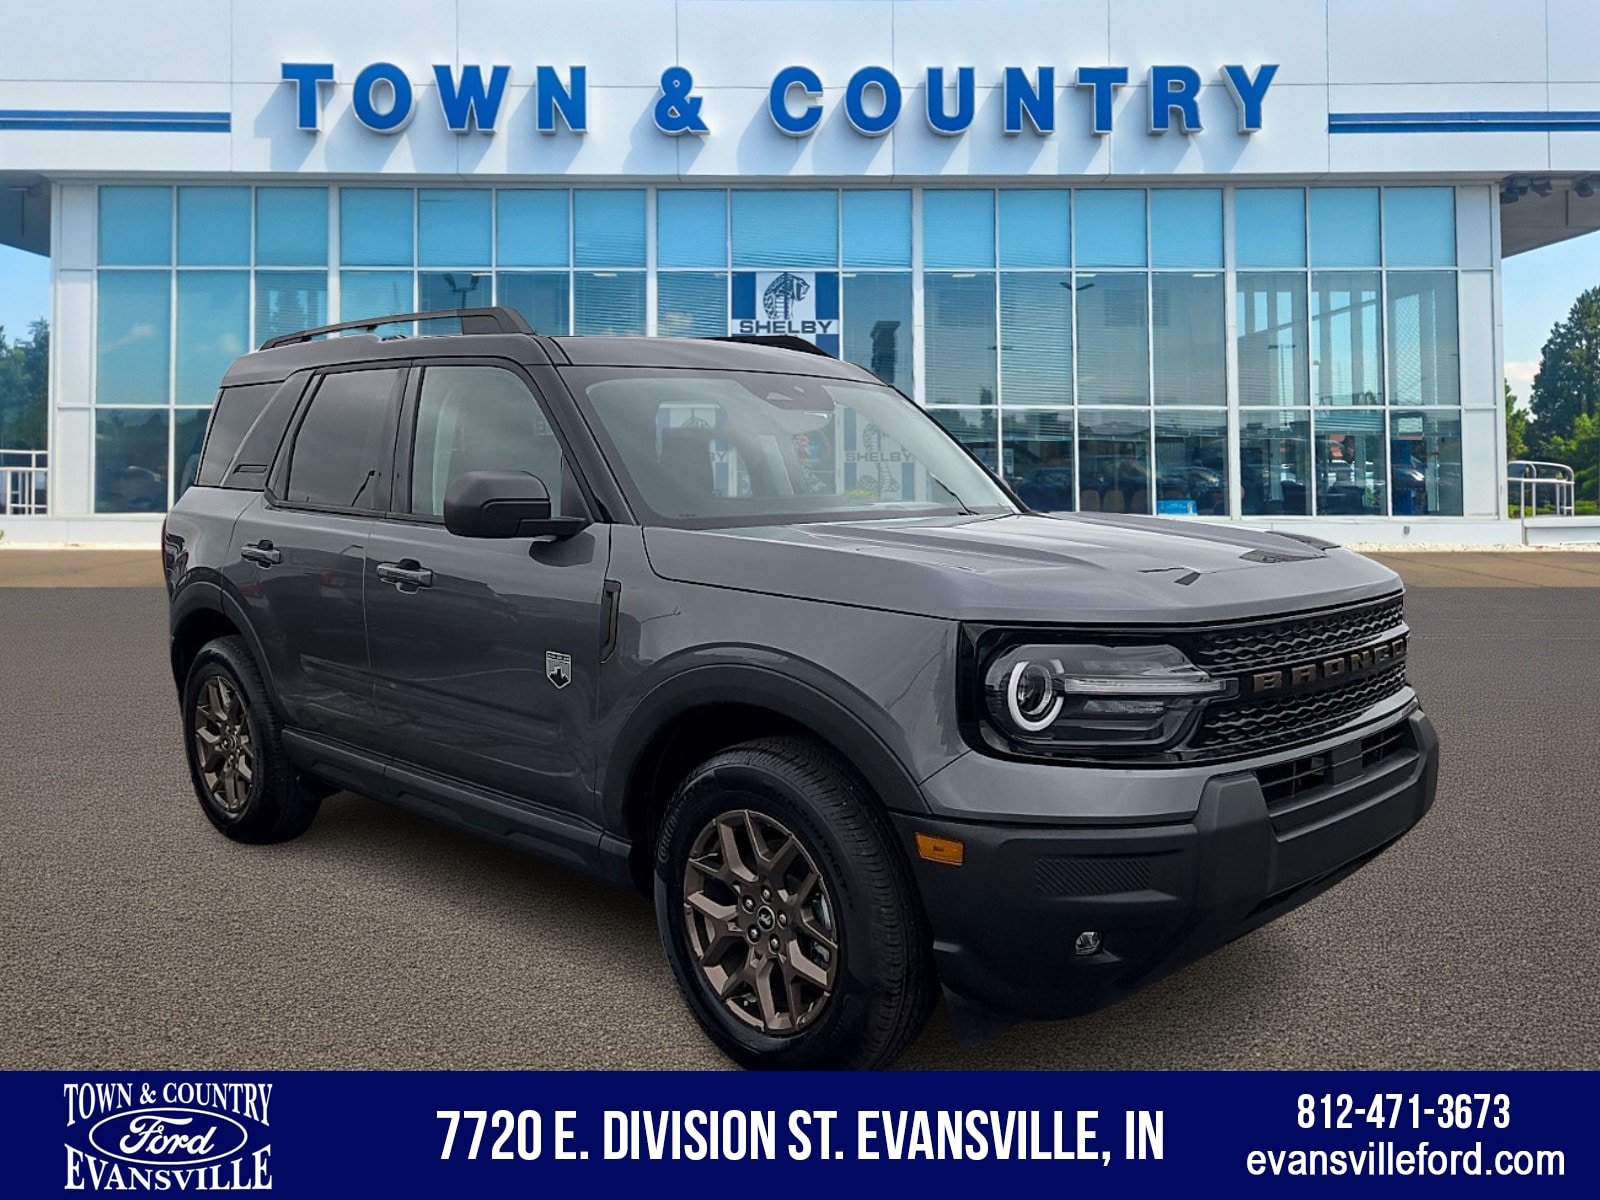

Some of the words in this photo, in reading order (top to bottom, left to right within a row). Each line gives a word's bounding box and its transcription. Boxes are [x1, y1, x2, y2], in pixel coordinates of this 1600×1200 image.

[281, 62, 589, 136] TOWN
[652, 65, 710, 137] &
[768, 63, 1280, 138] COUNTRY
[739, 320, 833, 334] SHELBY
[845, 451, 913, 463] SHELBY
[1253, 638, 1408, 692] BRONCO
